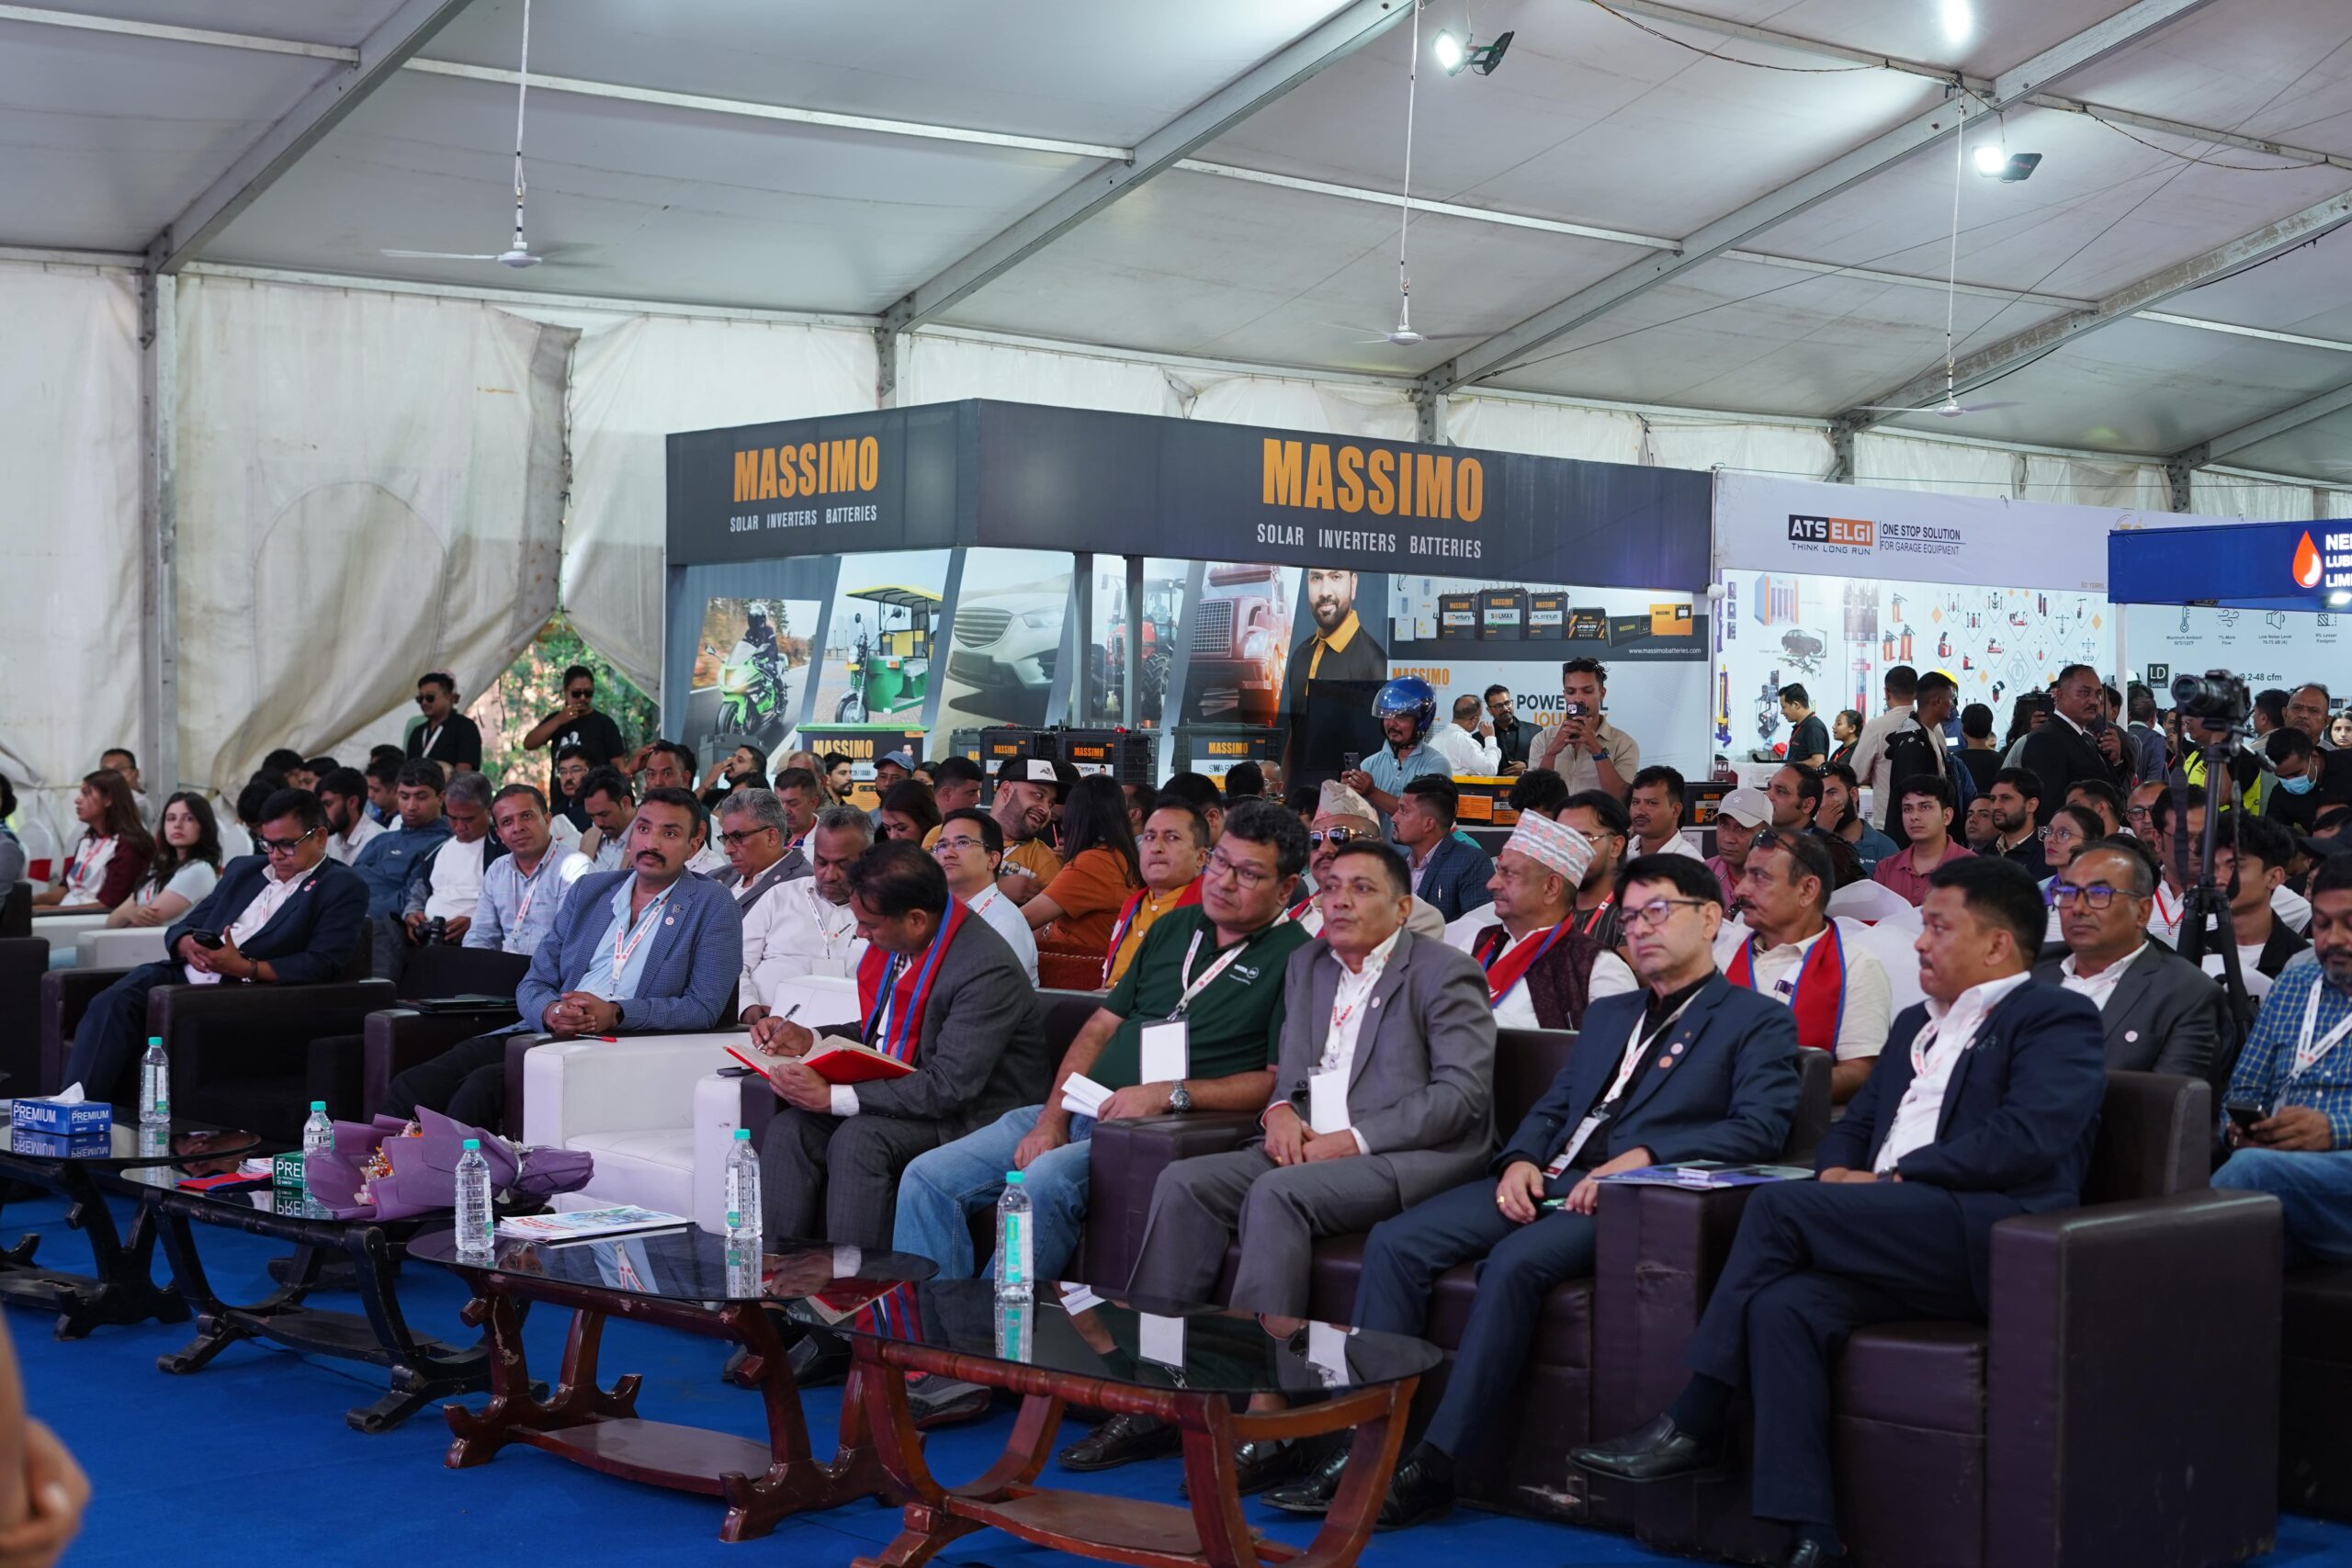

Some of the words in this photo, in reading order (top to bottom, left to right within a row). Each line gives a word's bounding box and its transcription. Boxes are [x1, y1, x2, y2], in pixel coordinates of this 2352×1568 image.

[733, 435, 879, 502] MASSIMO
[1262, 438, 1484, 523] MASSIMO
[729, 514, 759, 533] SOLAR
[766, 510, 817, 529] INVERTERS
[826, 504, 877, 525] BATTERIES
[1792, 519, 1826, 538] ATS
[1831, 522, 1871, 542] ELGI
[1883, 524, 1900, 536] ONE
[1900, 525, 1921, 537] STOP
[1922, 526, 1961, 540] SOLUTION
[1257, 523, 1304, 546] SOLAR
[1318, 528, 1396, 553] INVERTERS
[1410, 536, 1482, 558] BATTERIES
[1881, 540, 1894, 551] FOR
[1895, 541, 1922, 553] GARAGE
[1923, 544, 1960, 556] EQUIPMENT
[2325, 534, 2352, 550] NE
[1792, 543, 1819, 551] THINK
[1823, 545, 1848, 554] LONG
[1851, 547, 1871, 556] RUN
[2325, 555, 2352, 568] LUB
[2325, 574, 2352, 587] LIM
[2150, 667, 2166, 680] LD
[2267, 672, 2282, 681] cfm
[813, 739, 873, 759] MASSIMO
[1074, 747, 1104, 757] MASSIMO
[1208, 742, 1248, 754] MASSIMO
[13, 1105, 56, 1122] PREMIUM
[72, 1111, 108, 1122] PREMIUM
